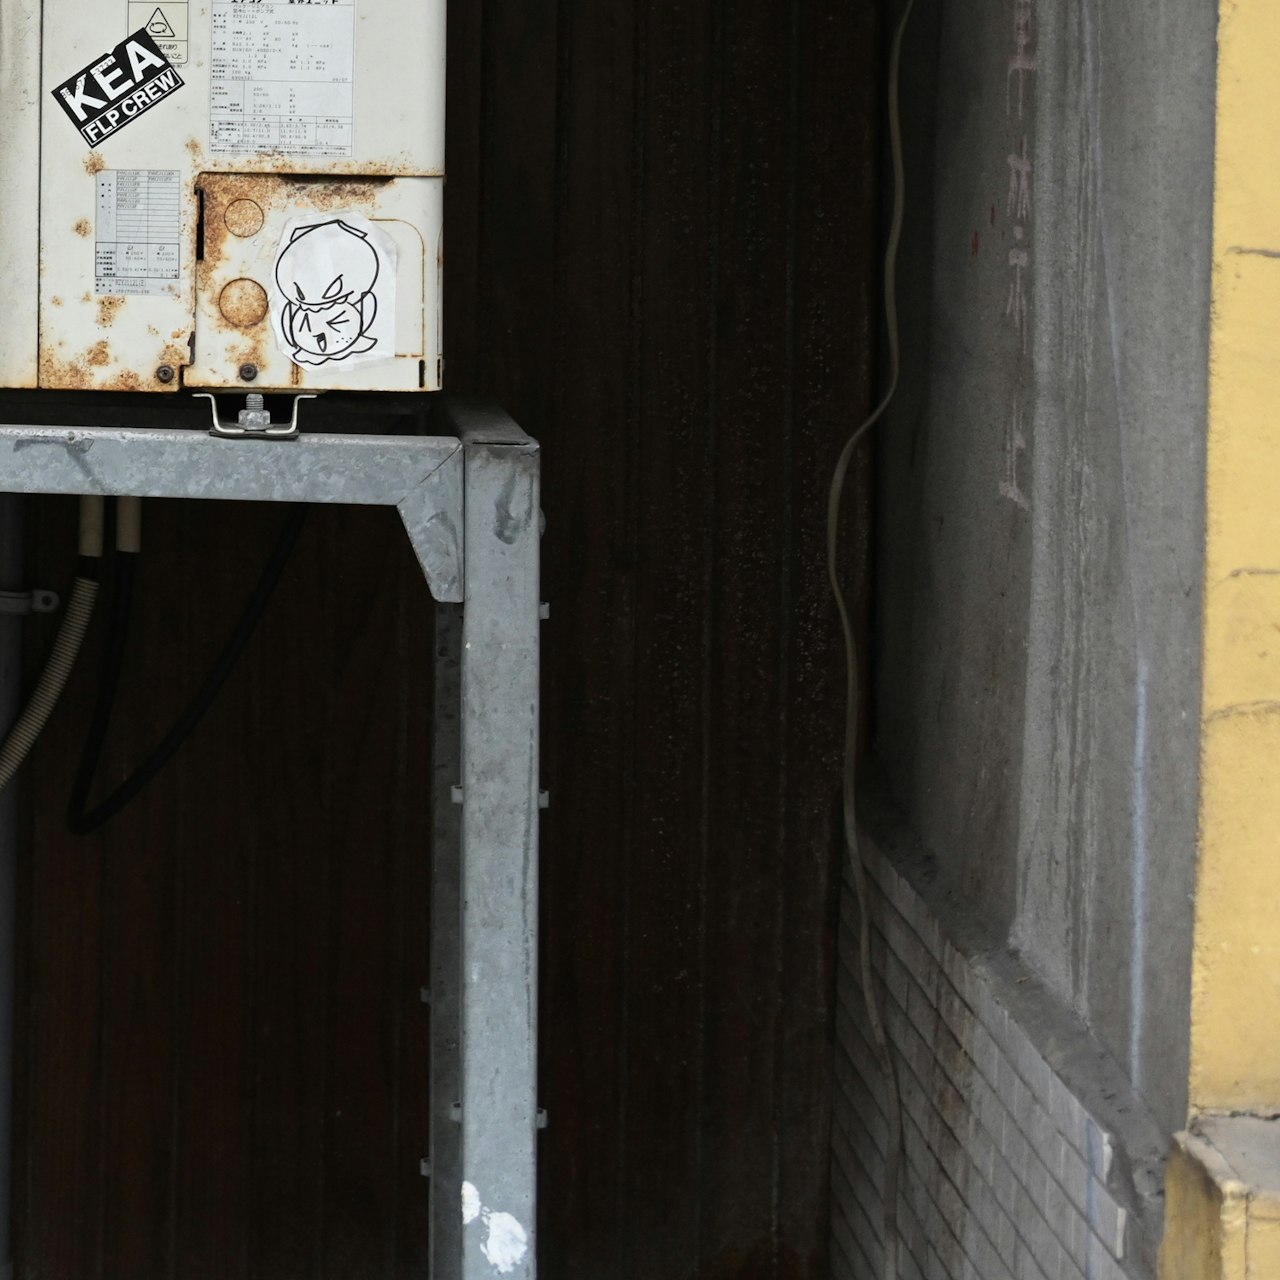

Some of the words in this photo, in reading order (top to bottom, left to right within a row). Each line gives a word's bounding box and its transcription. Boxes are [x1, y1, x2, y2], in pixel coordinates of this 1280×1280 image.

[59, 39, 166, 122] KEA
[85, 109, 120, 141] FLP
[121, 70, 175, 116] CREW
